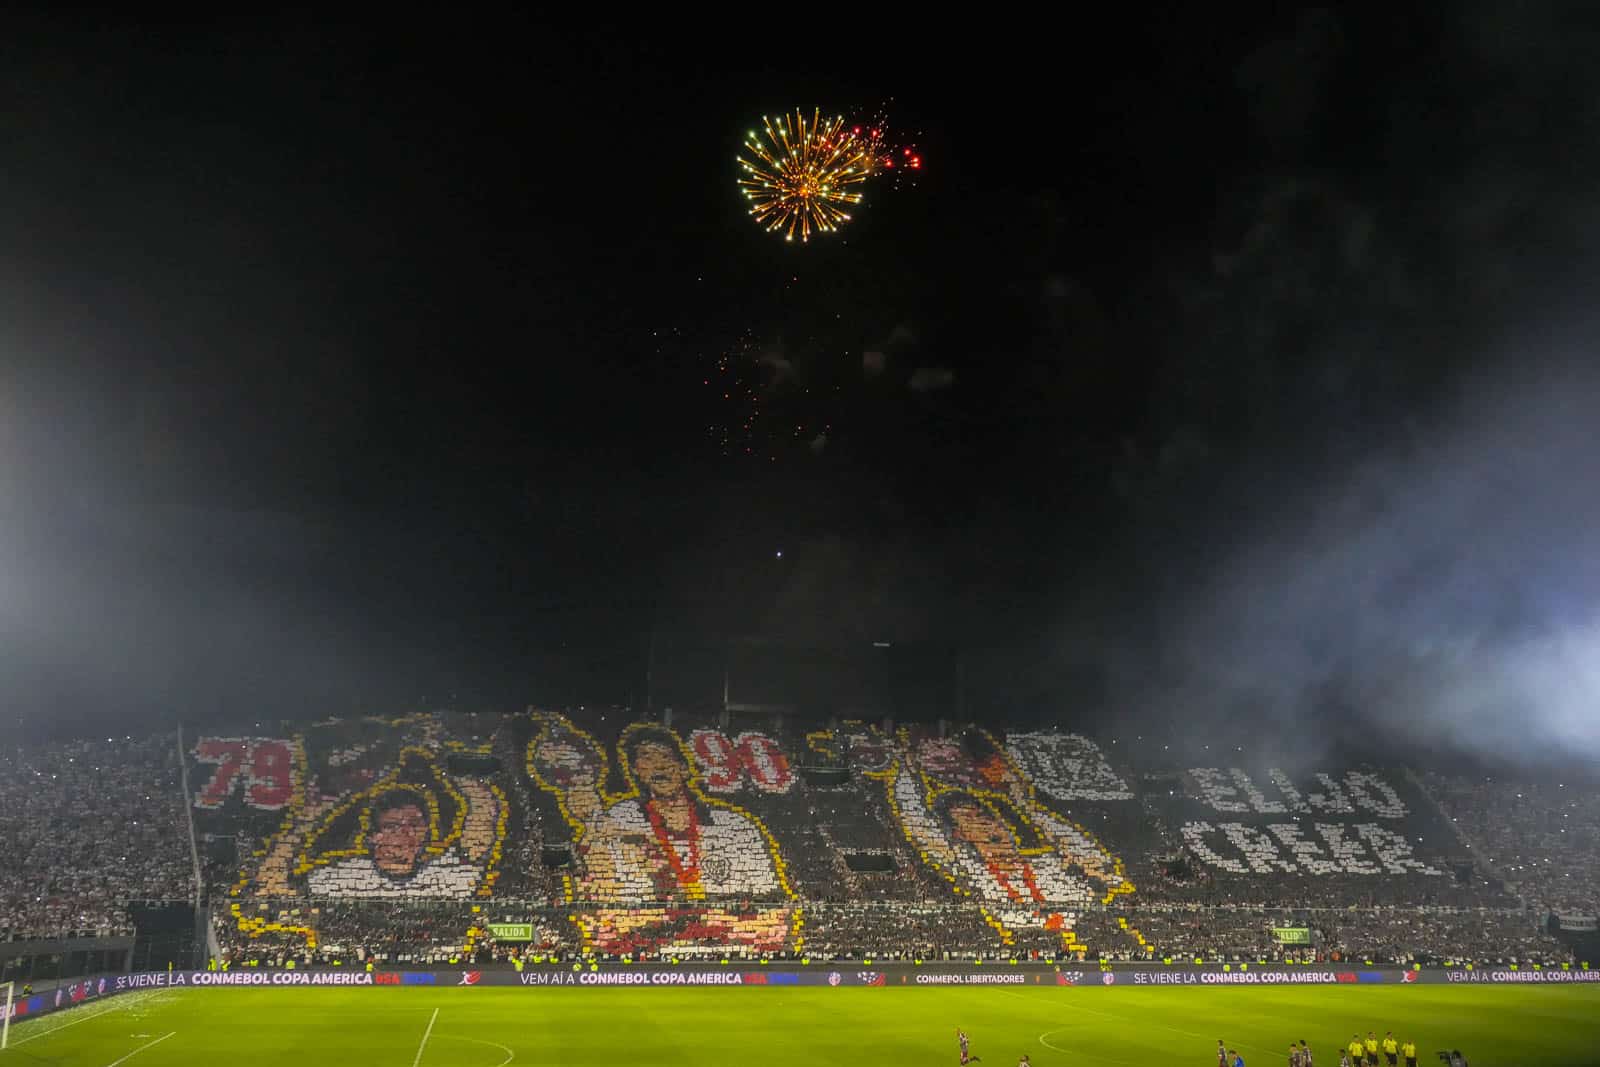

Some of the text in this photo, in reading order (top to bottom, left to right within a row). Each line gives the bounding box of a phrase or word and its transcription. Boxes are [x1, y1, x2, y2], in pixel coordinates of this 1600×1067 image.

[688, 729, 795, 793] 90
[192, 736, 298, 809] 79
[1180, 821, 1442, 876] CREER
[492, 927, 525, 937] SALIDA
[116, 976, 127, 989] SE
[128, 973, 165, 987] VIENE
[169, 973, 186, 985] LA
[191, 972, 271, 985] CONMEBOL
[272, 972, 312, 985] COPA
[312, 972, 373, 985] AMERICA
[520, 973, 549, 985] VEM
[551, 971, 563, 985] AÍ
[565, 973, 575, 985] A
[579, 972, 650, 985] CONMEBOL
[652, 972, 687, 985] COPA
[687, 972, 742, 985] AMERICA
[965, 974, 1025, 984] LIBERTADORES
[1134, 972, 1148, 984] SE
[1149, 972, 1181, 984] VIENE
[1183, 972, 1197, 984] LA
[1200, 971, 1260, 983] CONMEBOL
[1261, 971, 1290, 983] COPA
[1290, 971, 1337, 983] AMERICA
[1447, 971, 1468, 982] VEM
[1482, 971, 1489, 982] A
[1491, 971, 1546, 982] CONMEBOL
[1547, 971, 1573, 982] COPA
